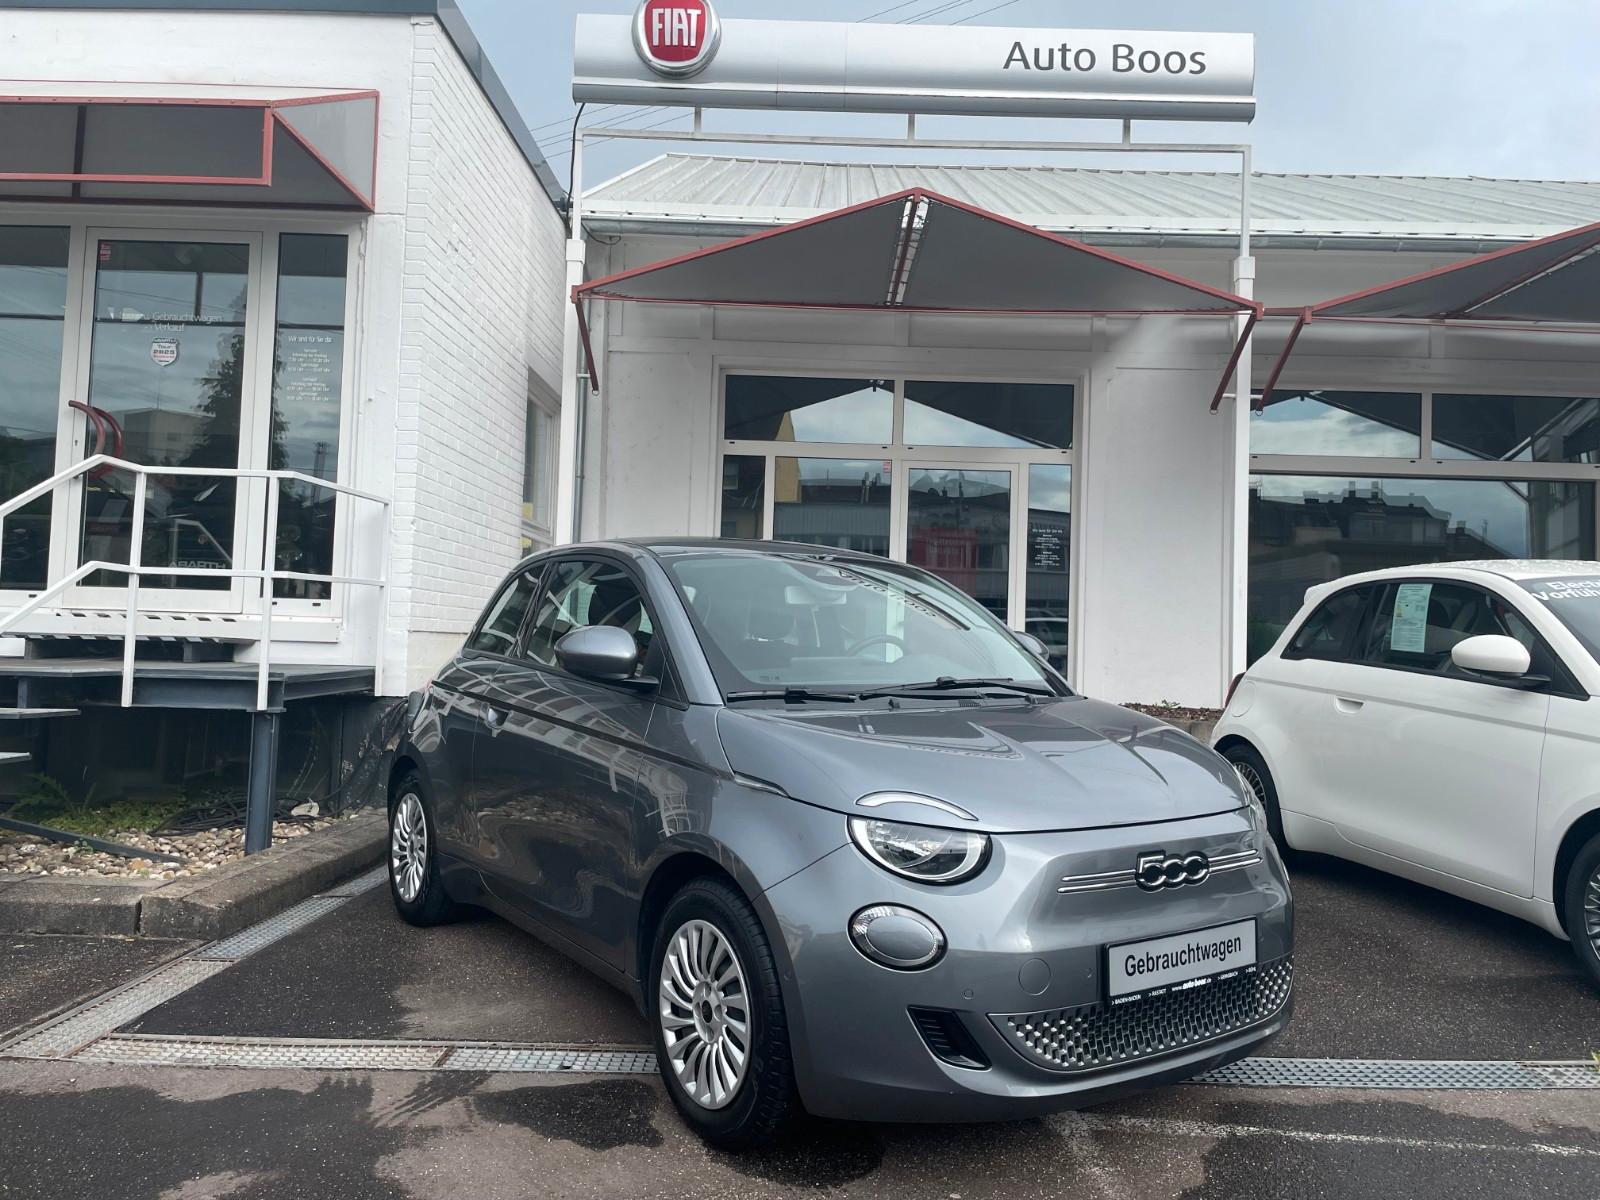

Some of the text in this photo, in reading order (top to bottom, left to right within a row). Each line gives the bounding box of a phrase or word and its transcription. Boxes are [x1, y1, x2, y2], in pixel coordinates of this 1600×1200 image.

[652, 8, 701, 47] FIAT
[1003, 41, 1206, 75] Auto Boos
[1531, 588, 1600, 601] Vorfüh
[1136, 850, 1210, 893] 500
[1125, 936, 1241, 976] Gebrauchtwagen
